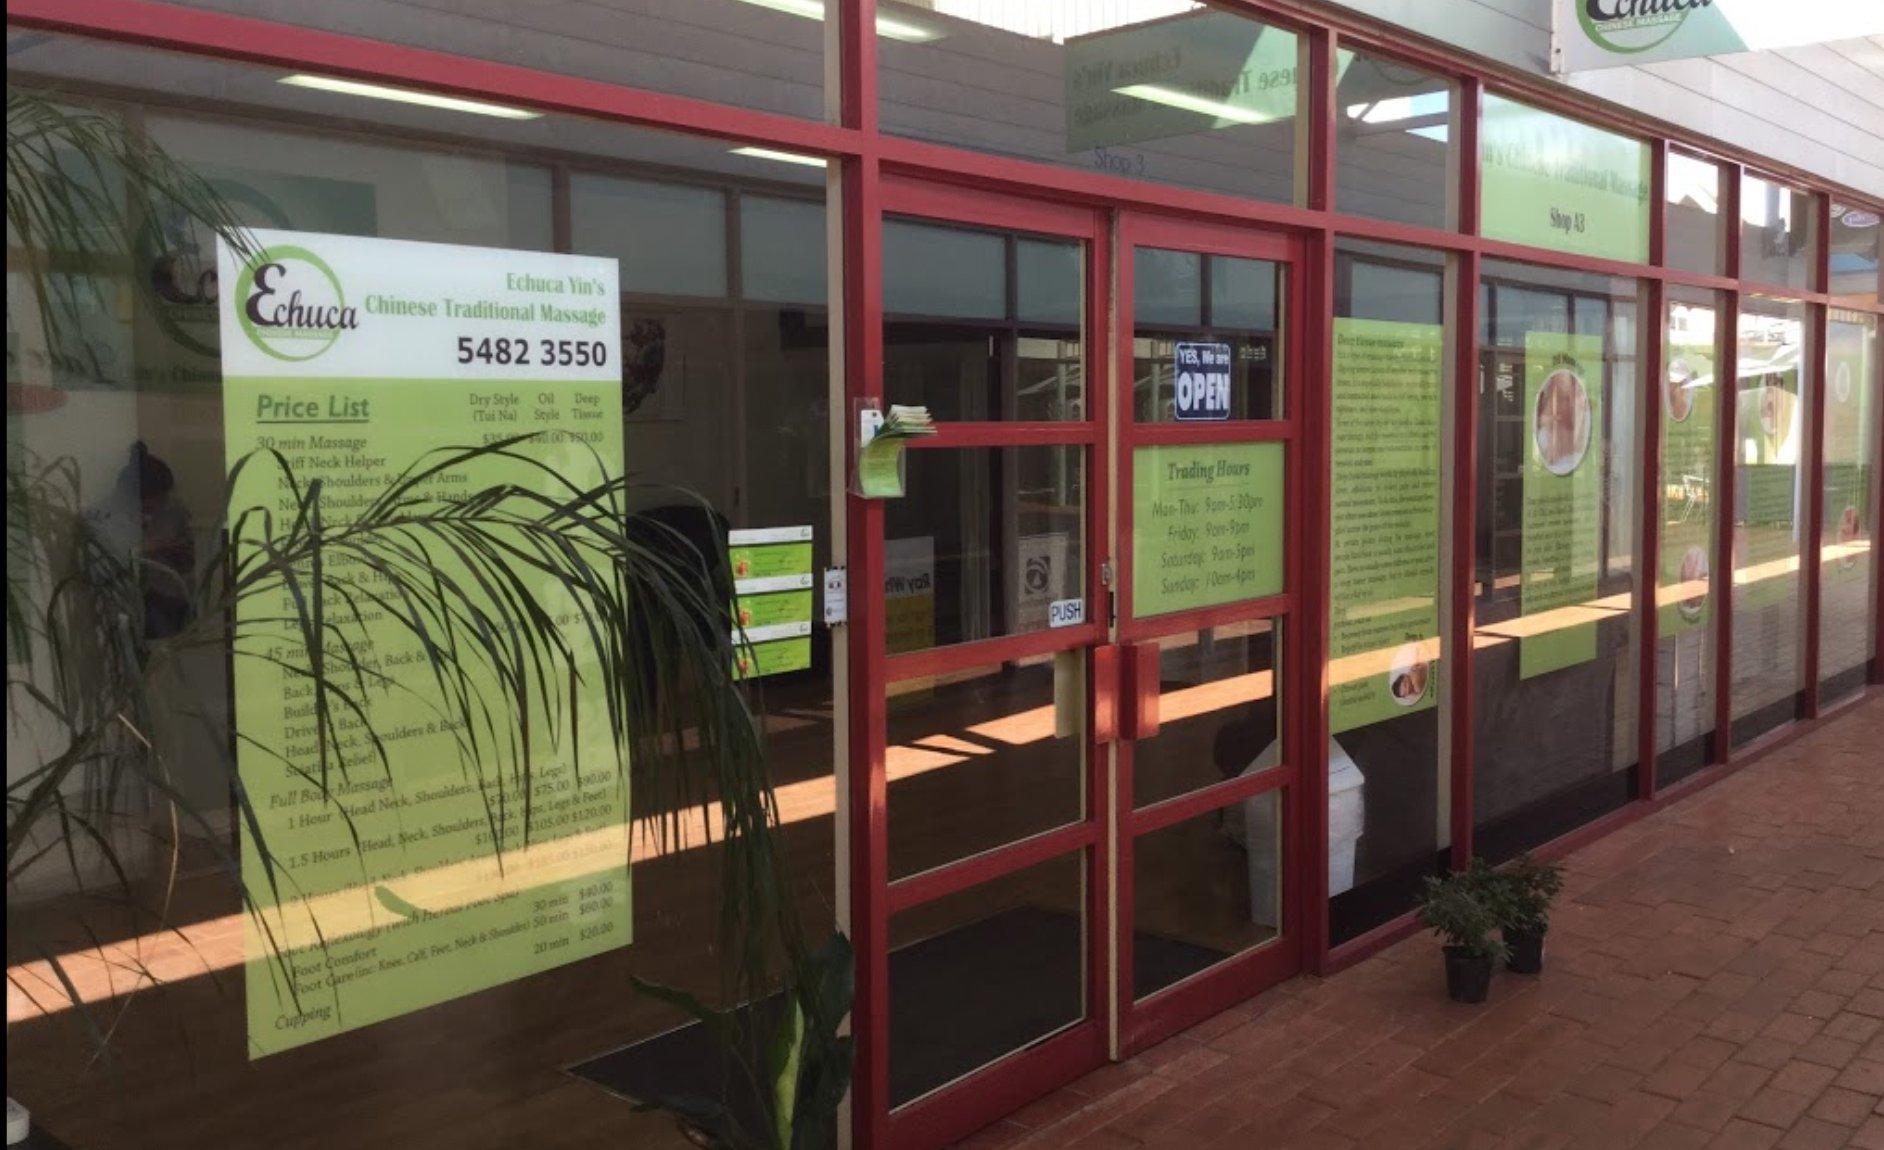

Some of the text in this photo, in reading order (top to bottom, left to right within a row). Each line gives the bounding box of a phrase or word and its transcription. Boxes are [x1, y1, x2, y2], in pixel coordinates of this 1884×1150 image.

[1550, 206, 1572, 235] Shop
[506, 272, 605, 296] Echuca Yin's
[246, 263, 359, 331] Echuca
[365, 294, 607, 328] Chinese Traditional Massage
[457, 336, 607, 367] 5482 3550
[1179, 350, 1200, 368] YES,
[469, 392, 519, 408] Dry Style
[538, 392, 554, 405] Oil
[574, 392, 601, 407] Deep
[1177, 371, 1230, 412] OPEN
[256, 394, 370, 419] Price List
[534, 408, 560, 423] Style
[278, 438, 305, 450] min
[309, 435, 367, 453] Massage
[309, 455, 341, 469] Neck
[345, 453, 386, 471] Helper
[1167, 459, 1250, 483] Trading Hours
[437, 470, 468, 484] Arms
[1051, 601, 1082, 622] PUSH
[269, 790, 298, 810] Full
[298, 812, 331, 828] Hour
[571, 804, 612, 823] $120.00
[289, 852, 309, 870] 1.5
[312, 846, 351, 864] Hours
[548, 895, 569, 908] min
[548, 910, 569, 925] min
[549, 936, 570, 950] min
[325, 947, 377, 970] Comfort
[274, 1004, 332, 1031] Cupping
